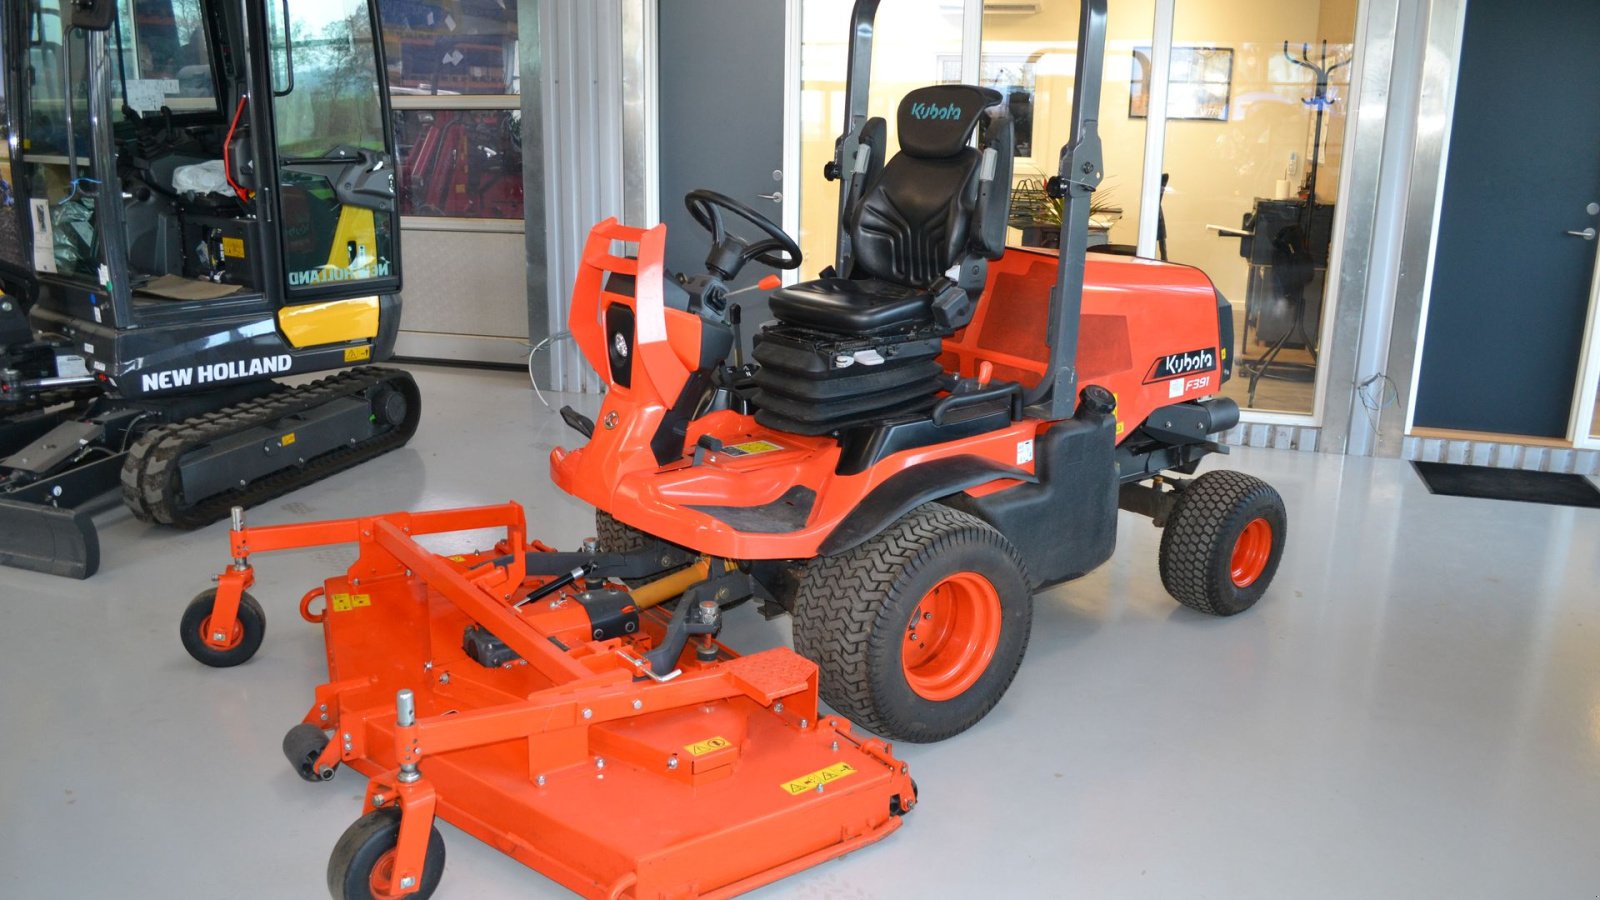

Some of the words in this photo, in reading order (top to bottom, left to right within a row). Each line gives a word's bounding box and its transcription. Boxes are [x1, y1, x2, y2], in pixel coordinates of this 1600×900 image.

[911, 103, 961, 120] Kubota
[1166, 350, 1212, 374] Kubota
[142, 367, 193, 392] NEW
[197, 354, 292, 383] HOLLAND
[1185, 376, 1210, 391] F391
